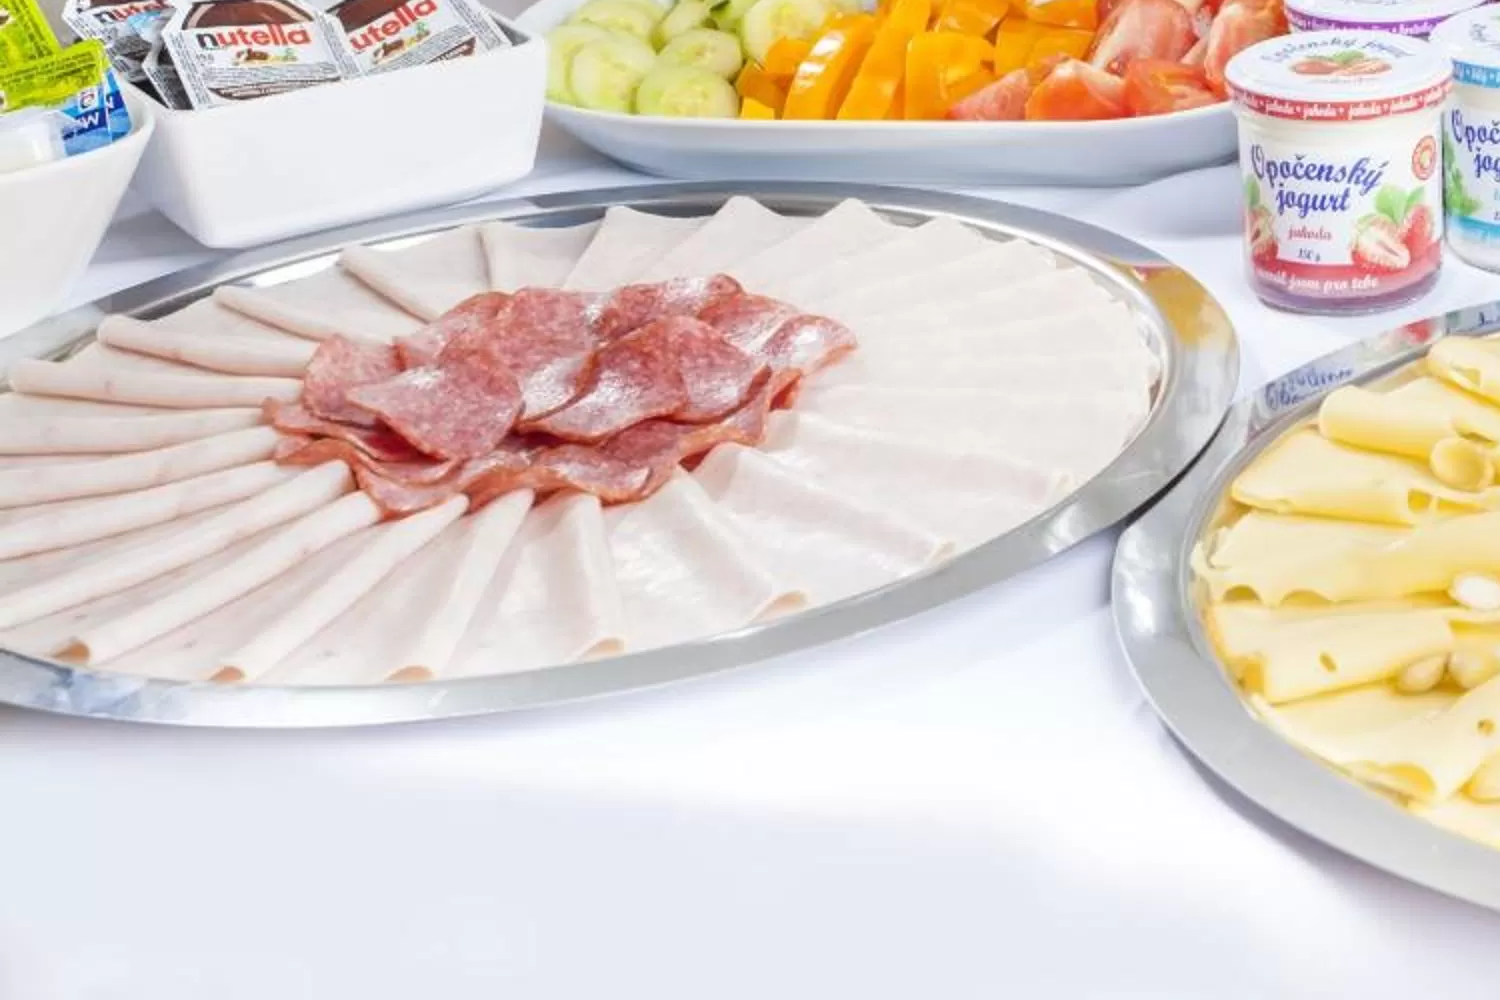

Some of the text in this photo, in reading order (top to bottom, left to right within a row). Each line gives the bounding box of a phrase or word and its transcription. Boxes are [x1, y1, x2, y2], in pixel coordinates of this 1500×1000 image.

[196, 23, 312, 50] nutella
[1251, 143, 1390, 196] Opočenský
[1275, 181, 1350, 219] jogurt
